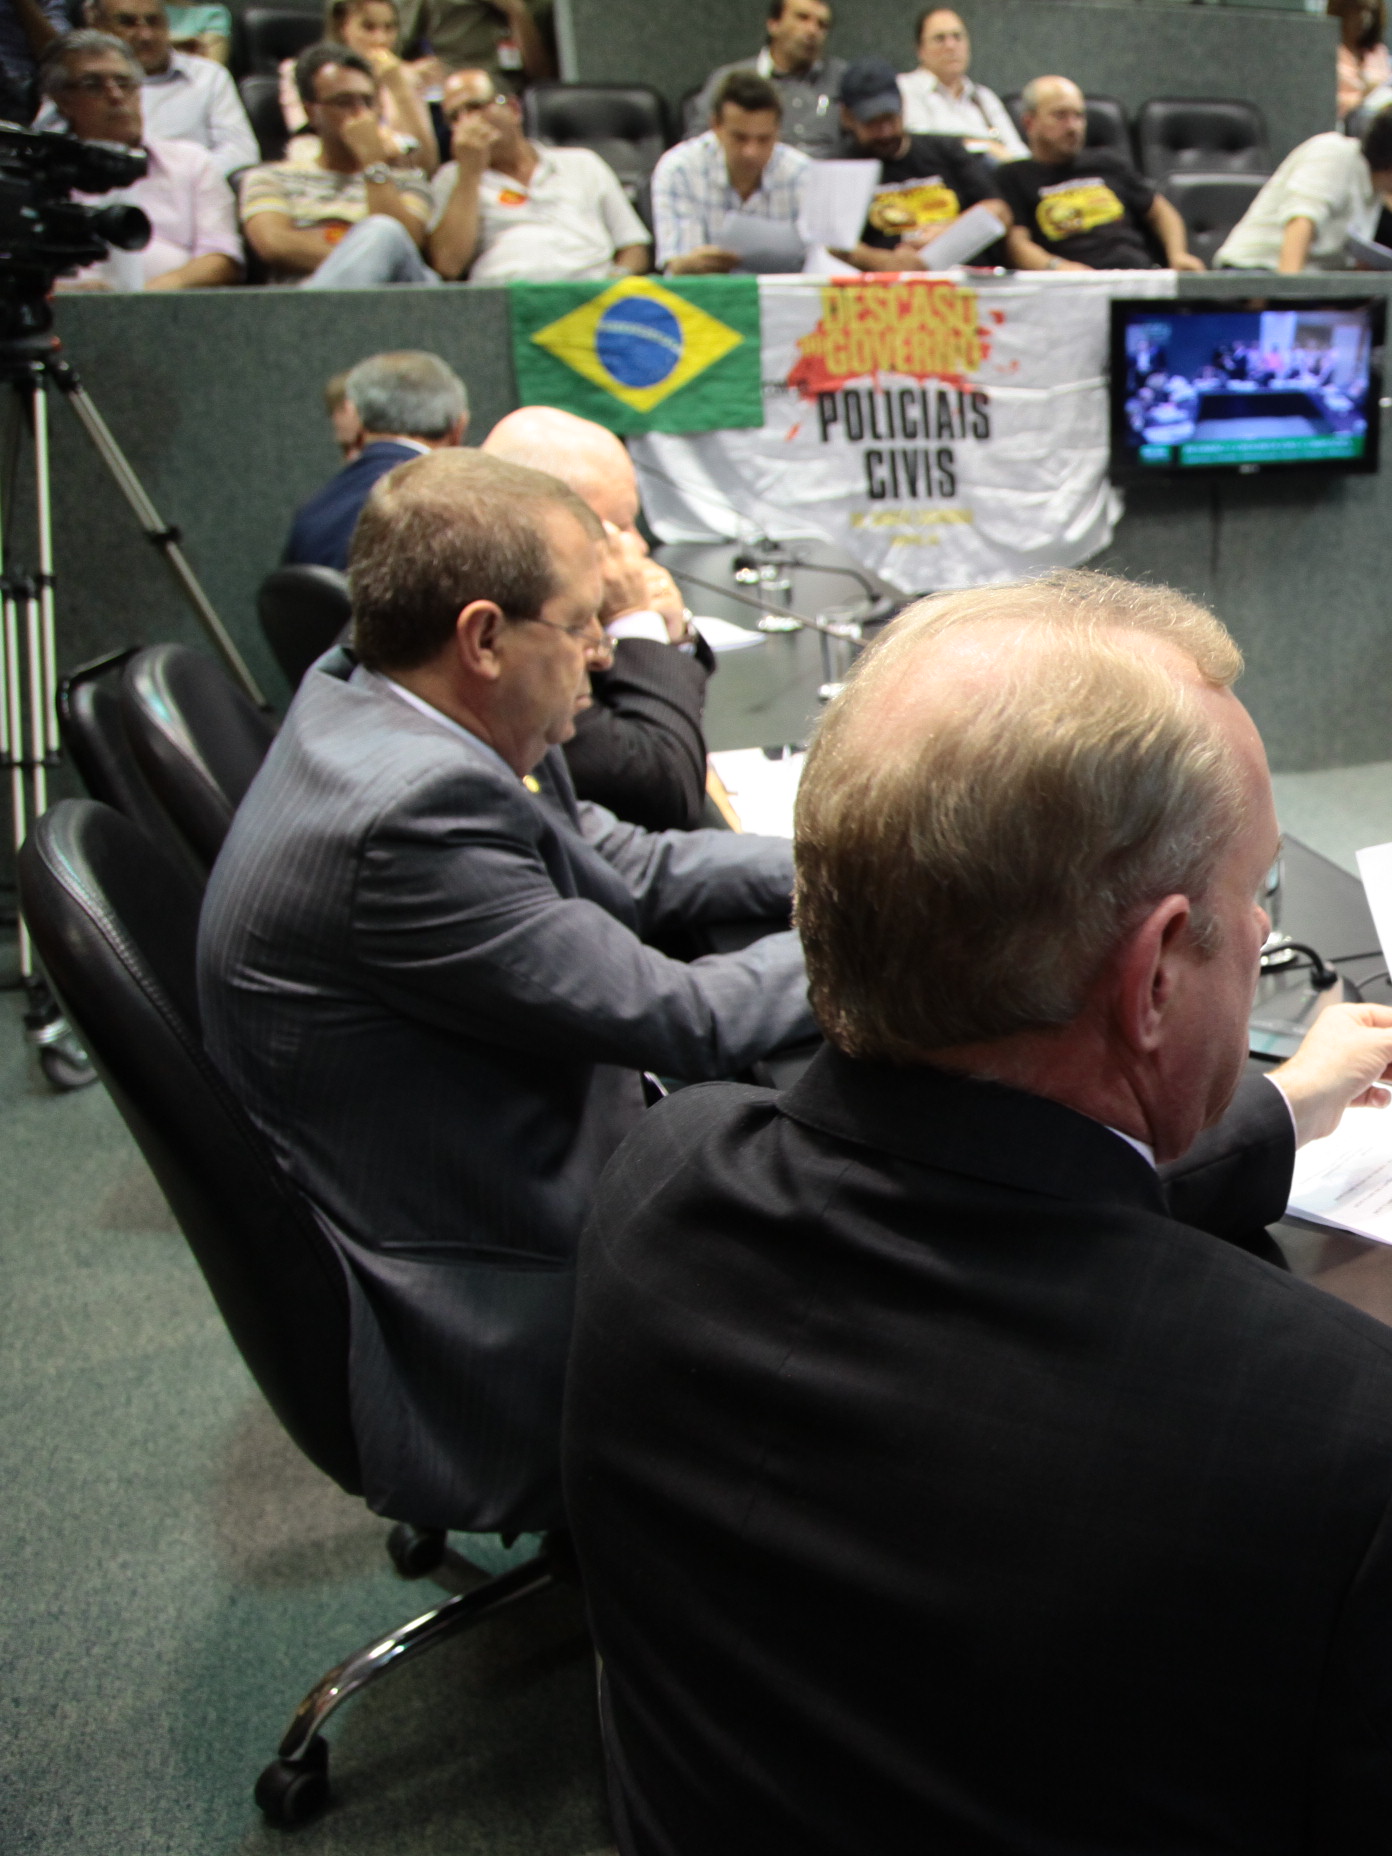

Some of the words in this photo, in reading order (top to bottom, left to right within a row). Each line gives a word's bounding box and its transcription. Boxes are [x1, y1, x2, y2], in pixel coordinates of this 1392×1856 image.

[822, 286, 977, 329] DESCASO
[819, 389, 991, 441] POLICIAIS
[867, 449, 957, 499] CIVIS
